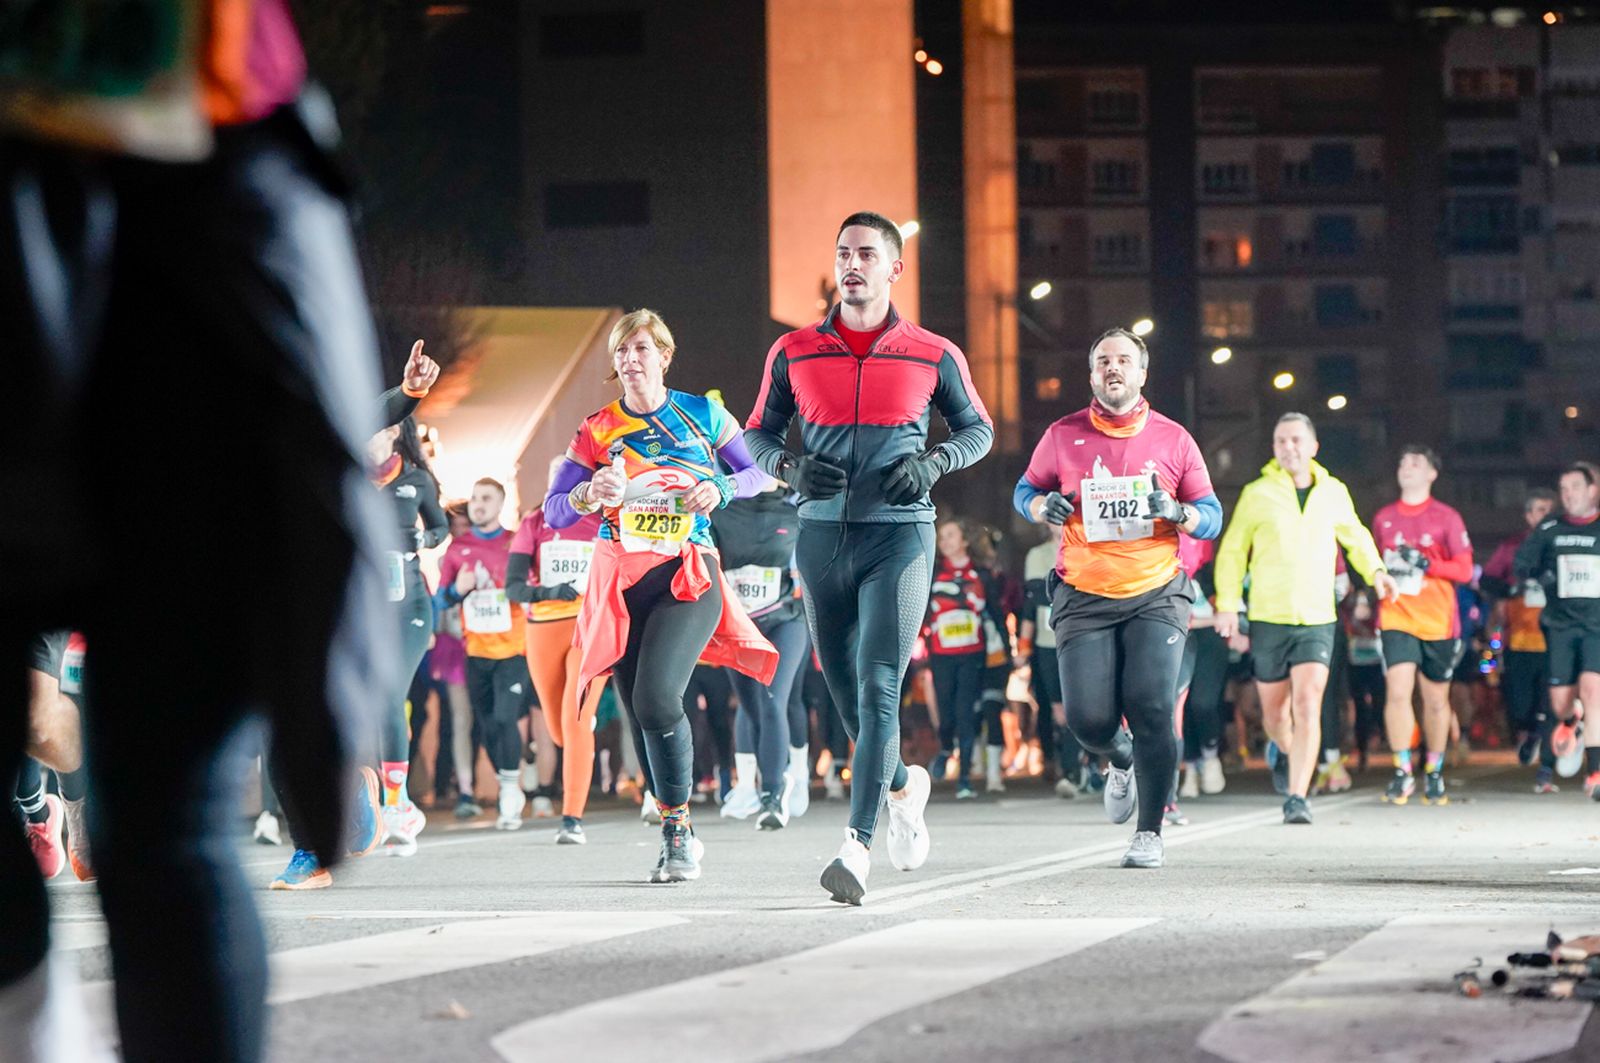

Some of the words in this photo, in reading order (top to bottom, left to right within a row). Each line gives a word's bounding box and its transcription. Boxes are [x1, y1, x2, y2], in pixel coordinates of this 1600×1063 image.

[1098, 499, 1139, 519] 2182
[634, 513, 682, 534] 2236
[551, 559, 588, 573] 3892
